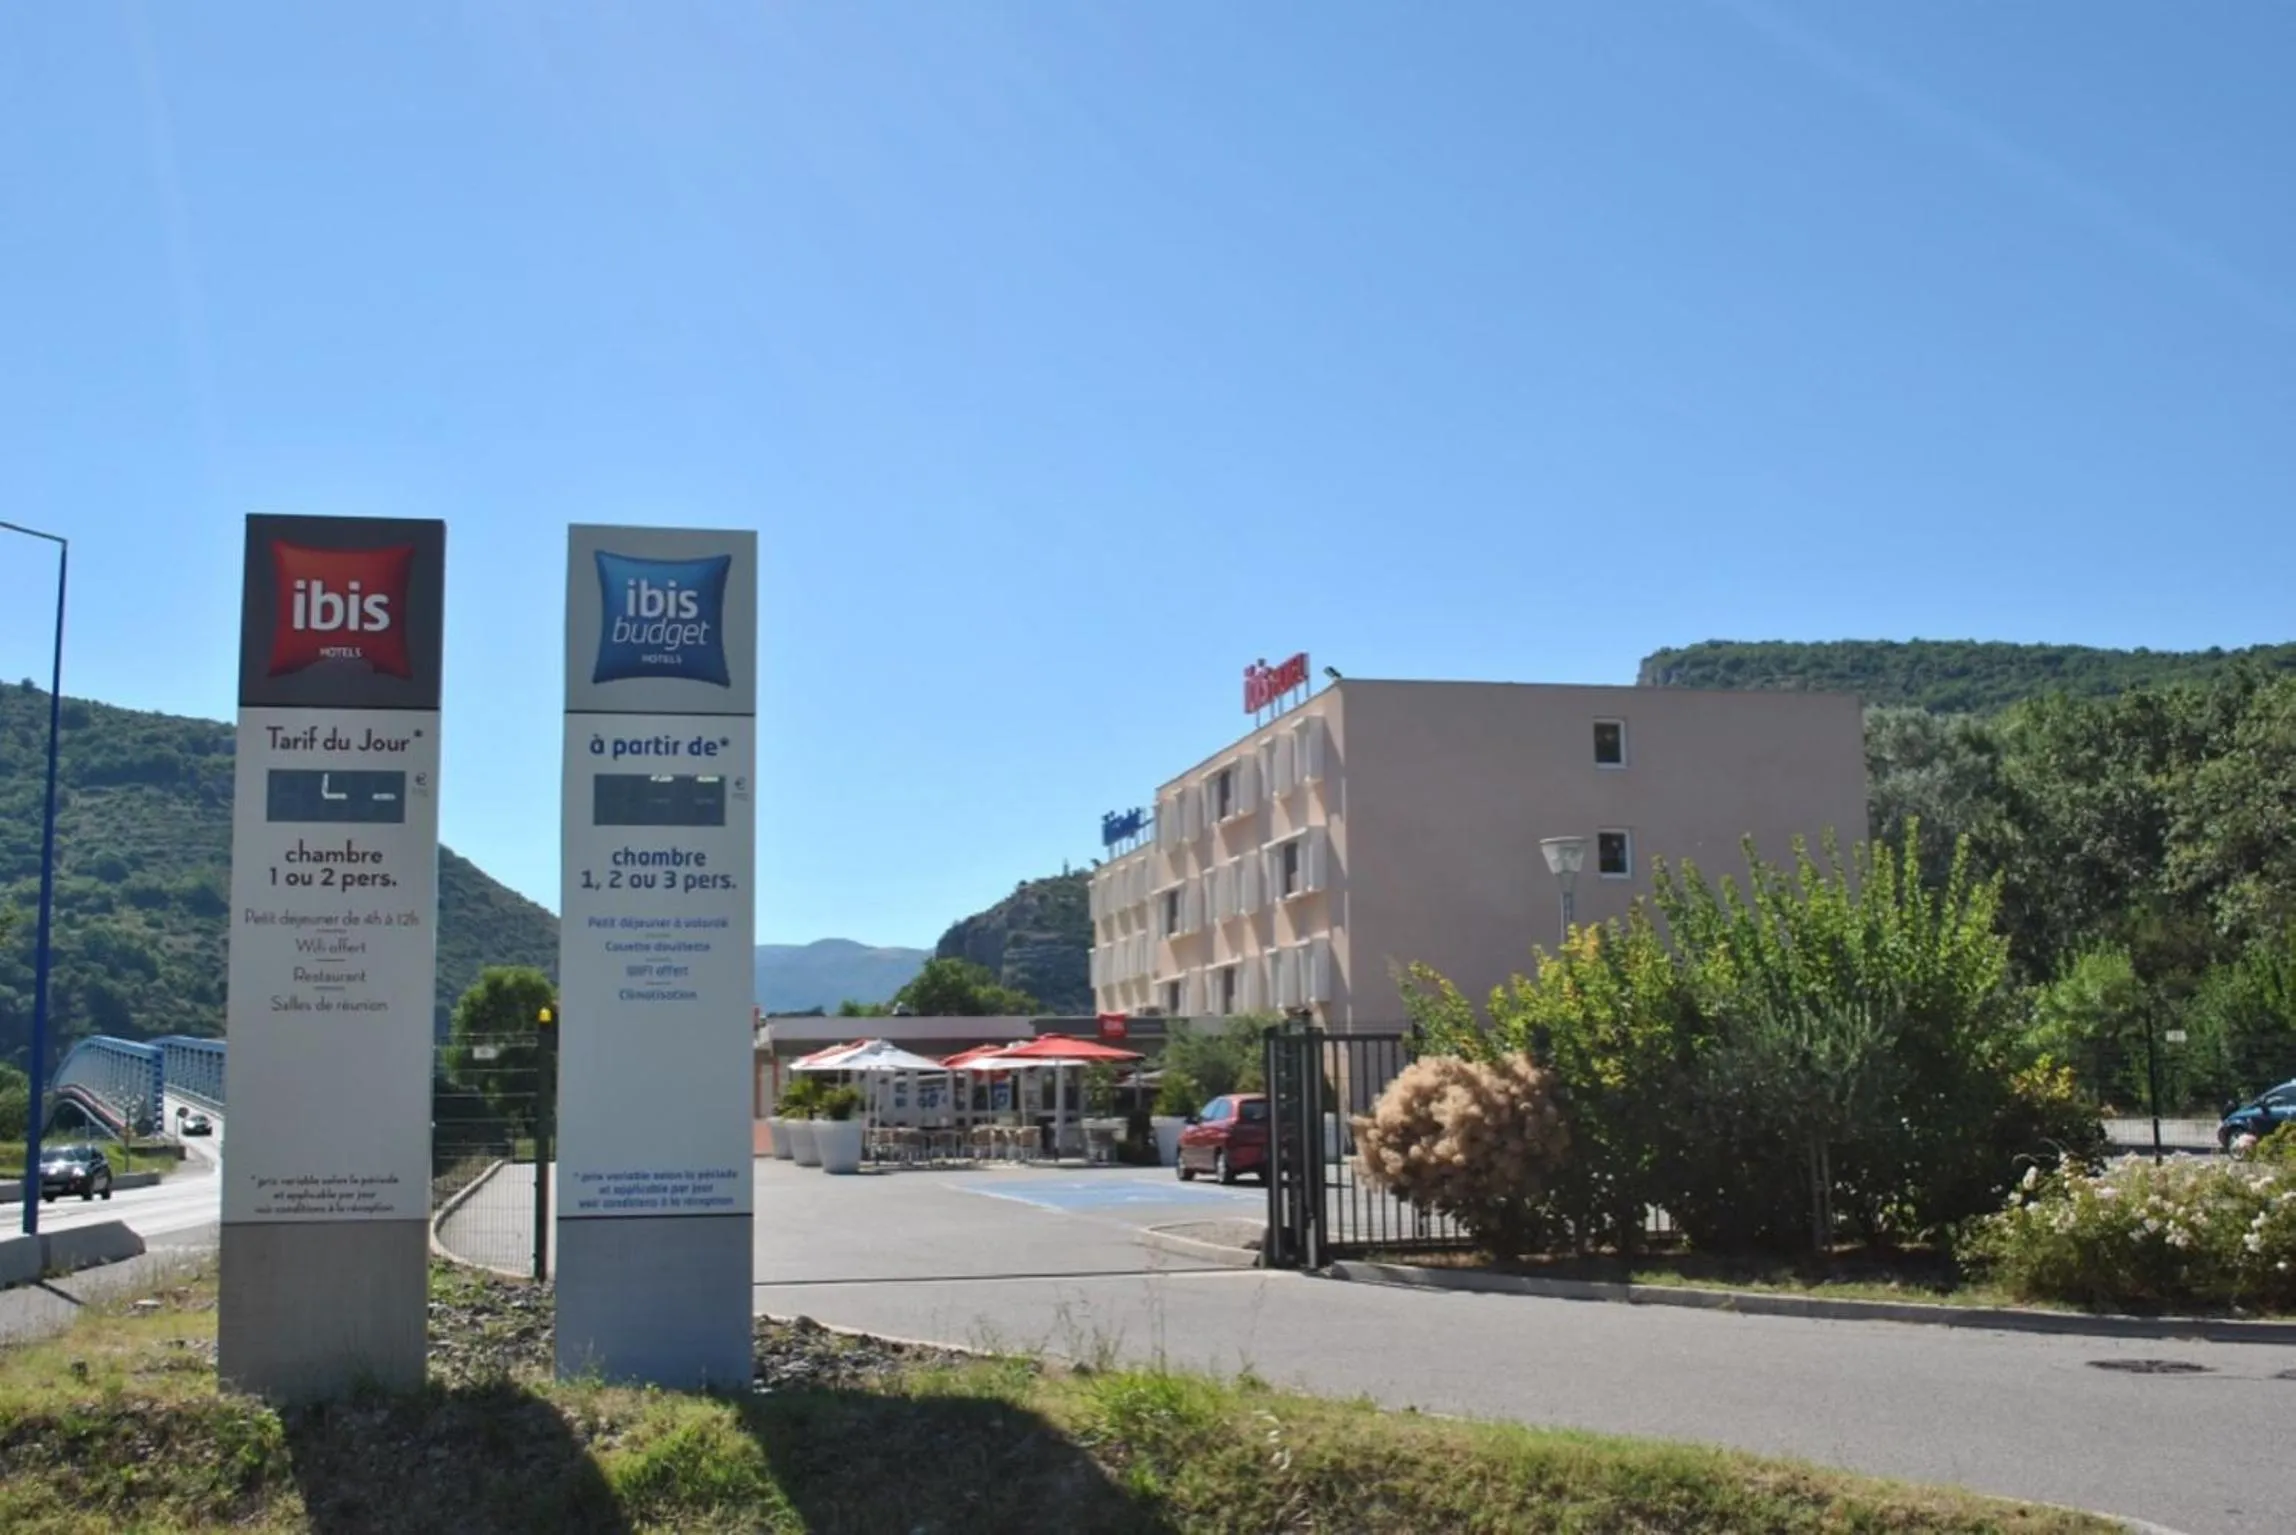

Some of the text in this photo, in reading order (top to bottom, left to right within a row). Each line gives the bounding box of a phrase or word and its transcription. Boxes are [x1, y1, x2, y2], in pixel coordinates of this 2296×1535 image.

[292, 579, 391, 631] ibis
[627, 578, 698, 619] ibis
[612, 616, 710, 650] budget
[319, 647, 362, 658] HOTELS
[642, 654, 682, 665] HOTELS
[266, 726, 318, 750] Tarif
[323, 727, 349, 751] du
[590, 734, 604, 755] à
[613, 736, 680, 761] partir
[285, 839, 383, 863] chambre
[612, 847, 706, 866] chambre
[270, 867, 397, 892] 1 ou 2 pers.
[581, 870, 737, 893] 1, 2 ou 3 pers.
[245, 908, 277, 924] Petit
[342, 910, 360, 925] de
[588, 917, 615, 928] Petit
[328, 938, 366, 953] offert
[293, 966, 366, 982] Restaurant
[271, 995, 312, 1012] Salles
[316, 996, 332, 1012] de
